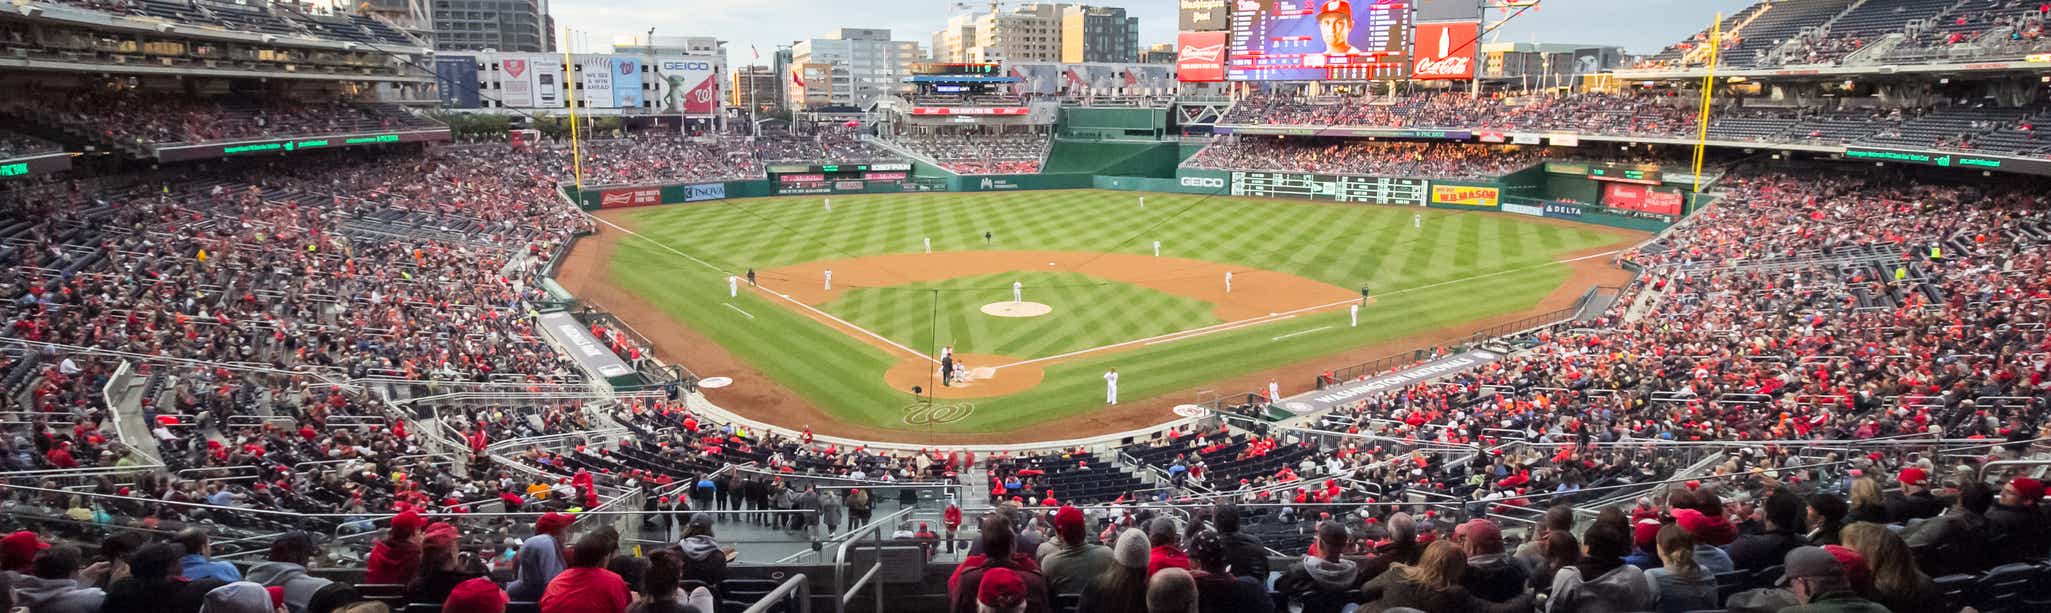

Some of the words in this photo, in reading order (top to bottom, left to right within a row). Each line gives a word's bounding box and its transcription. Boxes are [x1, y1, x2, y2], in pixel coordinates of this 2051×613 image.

[664, 62, 709, 71] GEICO
[1416, 57, 1470, 75] Coca-Cola
[1181, 177, 1224, 187] GEICO
[695, 184, 724, 196] INOVA
[1554, 206, 1582, 216] DELTA
[1314, 376, 1413, 404] WASHINGTON
[1402, 357, 1476, 381] NATIONALS
